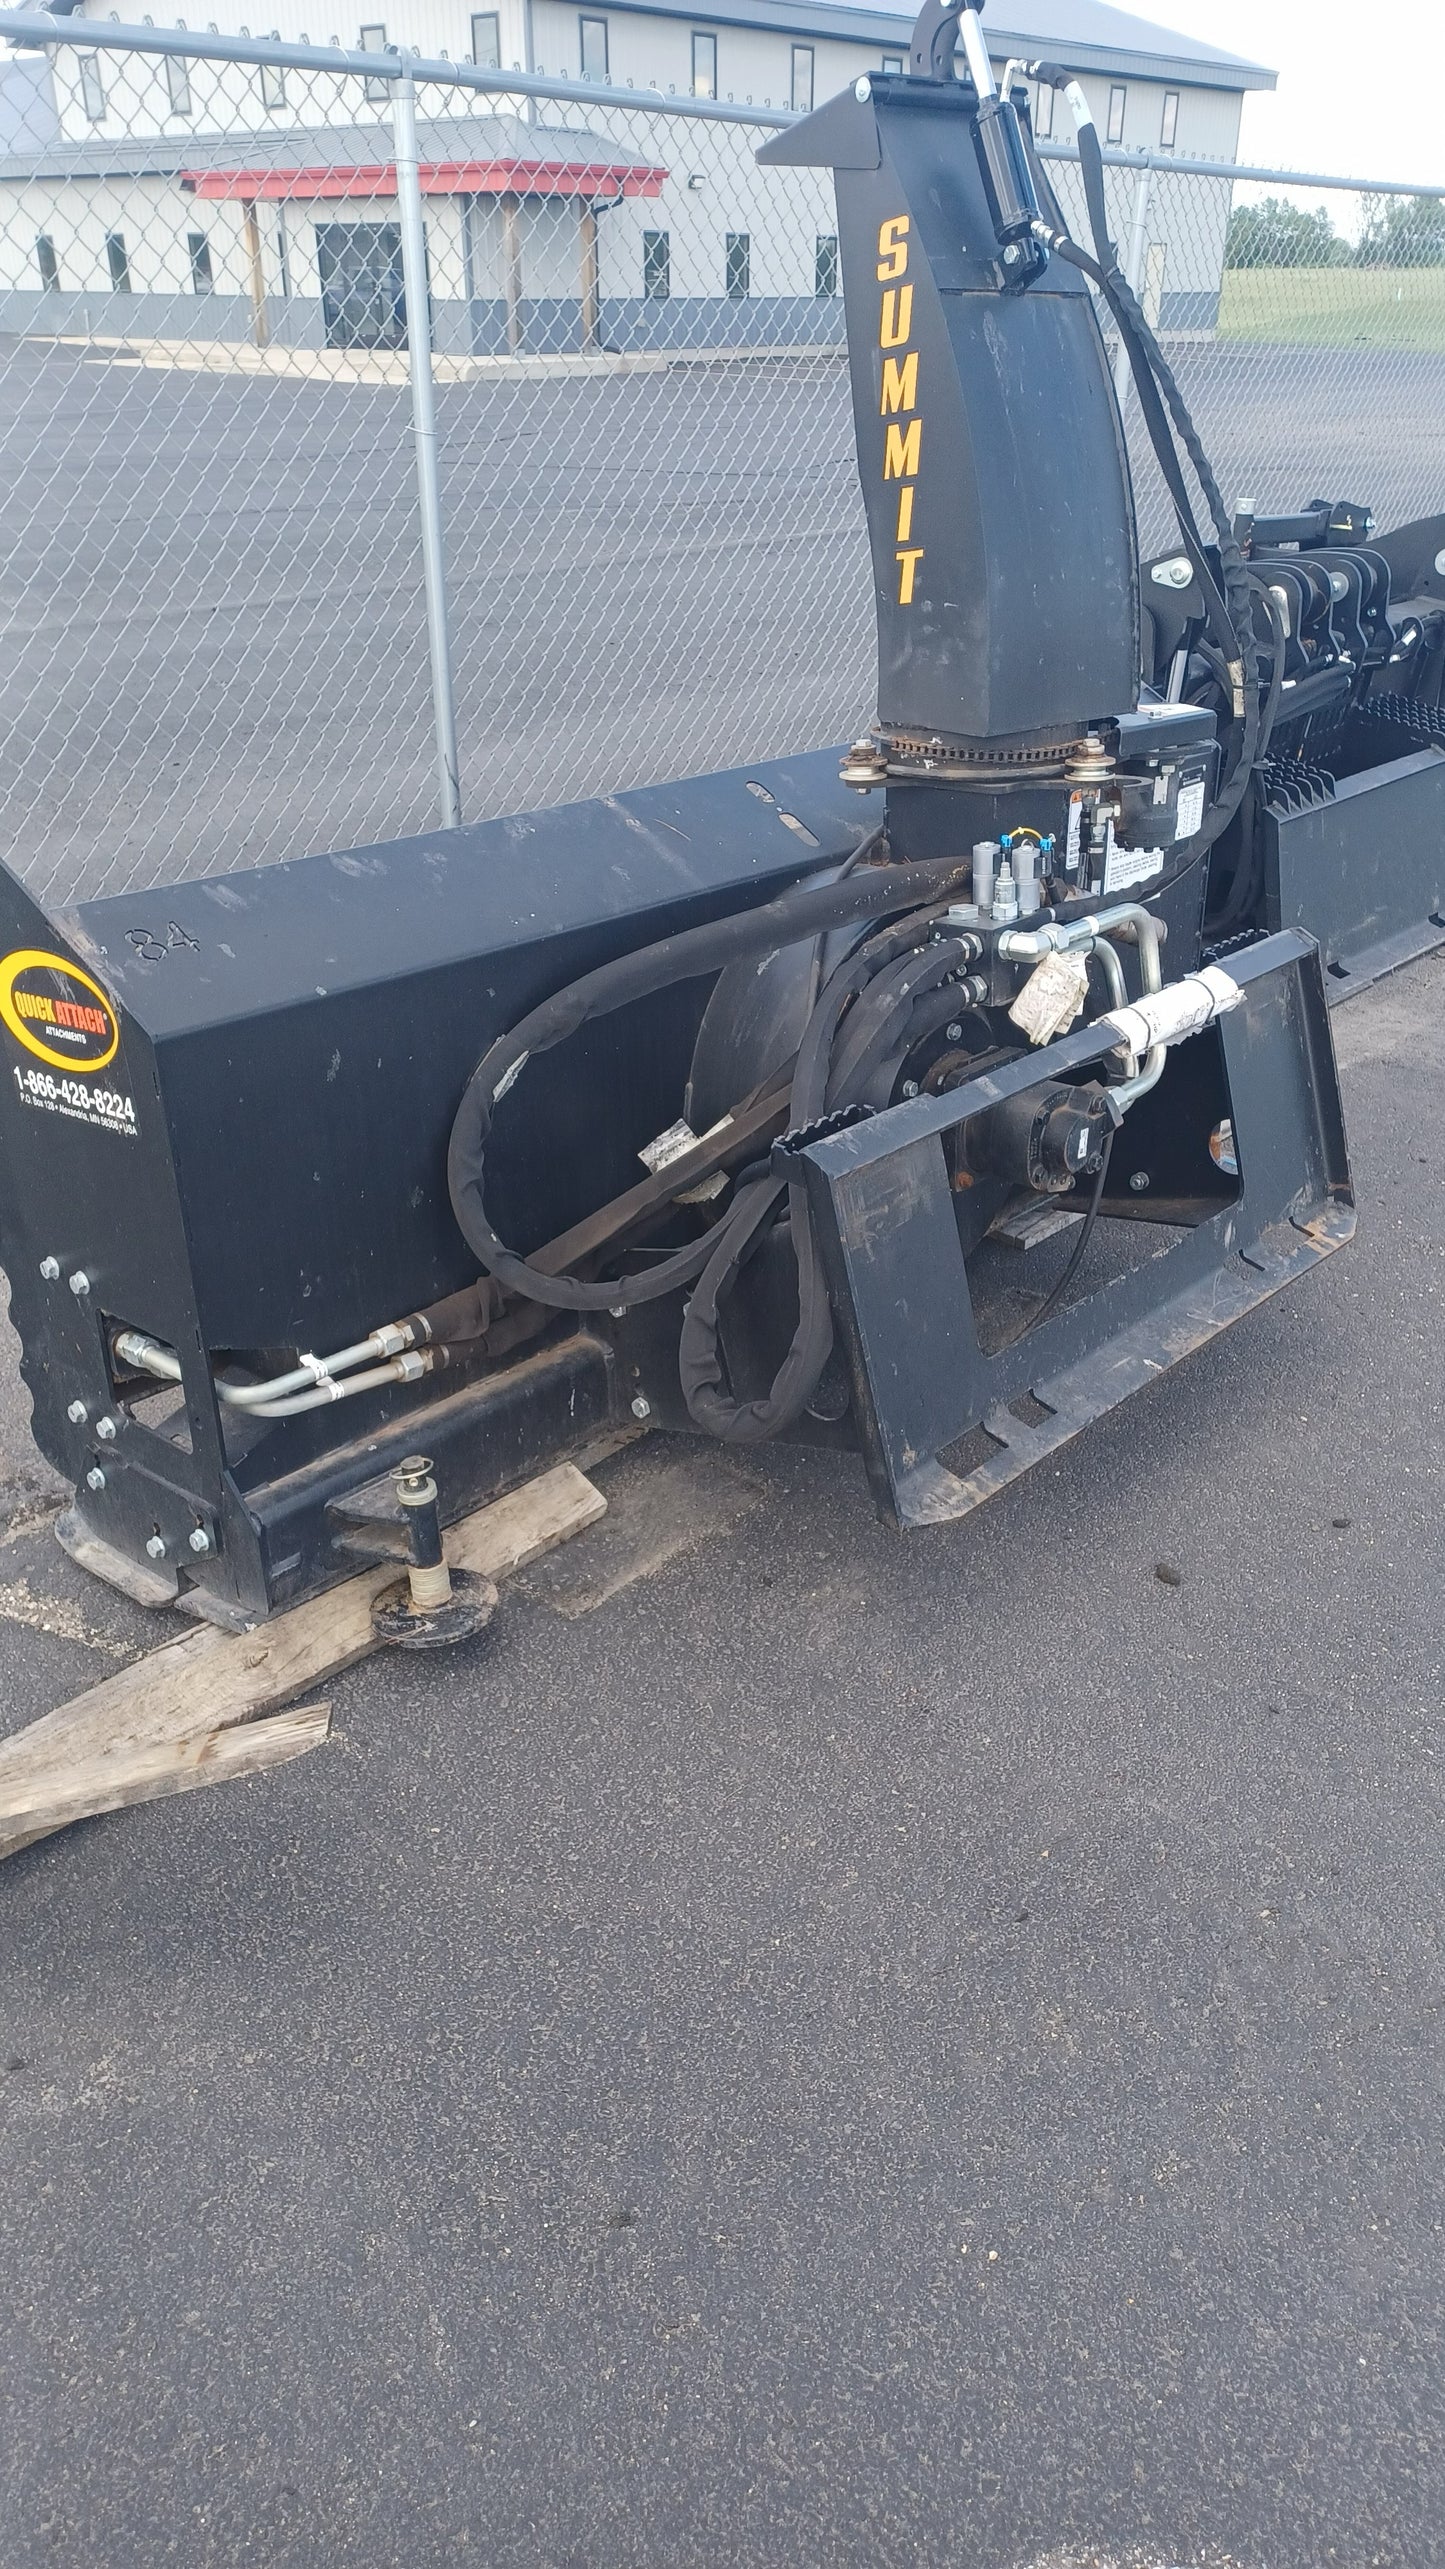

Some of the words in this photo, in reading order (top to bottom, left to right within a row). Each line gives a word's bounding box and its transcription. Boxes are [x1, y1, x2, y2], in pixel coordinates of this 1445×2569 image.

[876, 214, 924, 605] SUMMIT
[123, 920, 201, 961] 84
[14, 991, 57, 1023] QUICK
[45, 1025, 87, 1045] ATTACHMENTS
[13, 1065, 136, 1122] 1-866-428-8224
[19, 1092, 33, 1105] P.O.
[33, 1096, 44, 1108] Box
[89, 1113, 101, 1125] MN
[122, 1122, 138, 1136] USA
